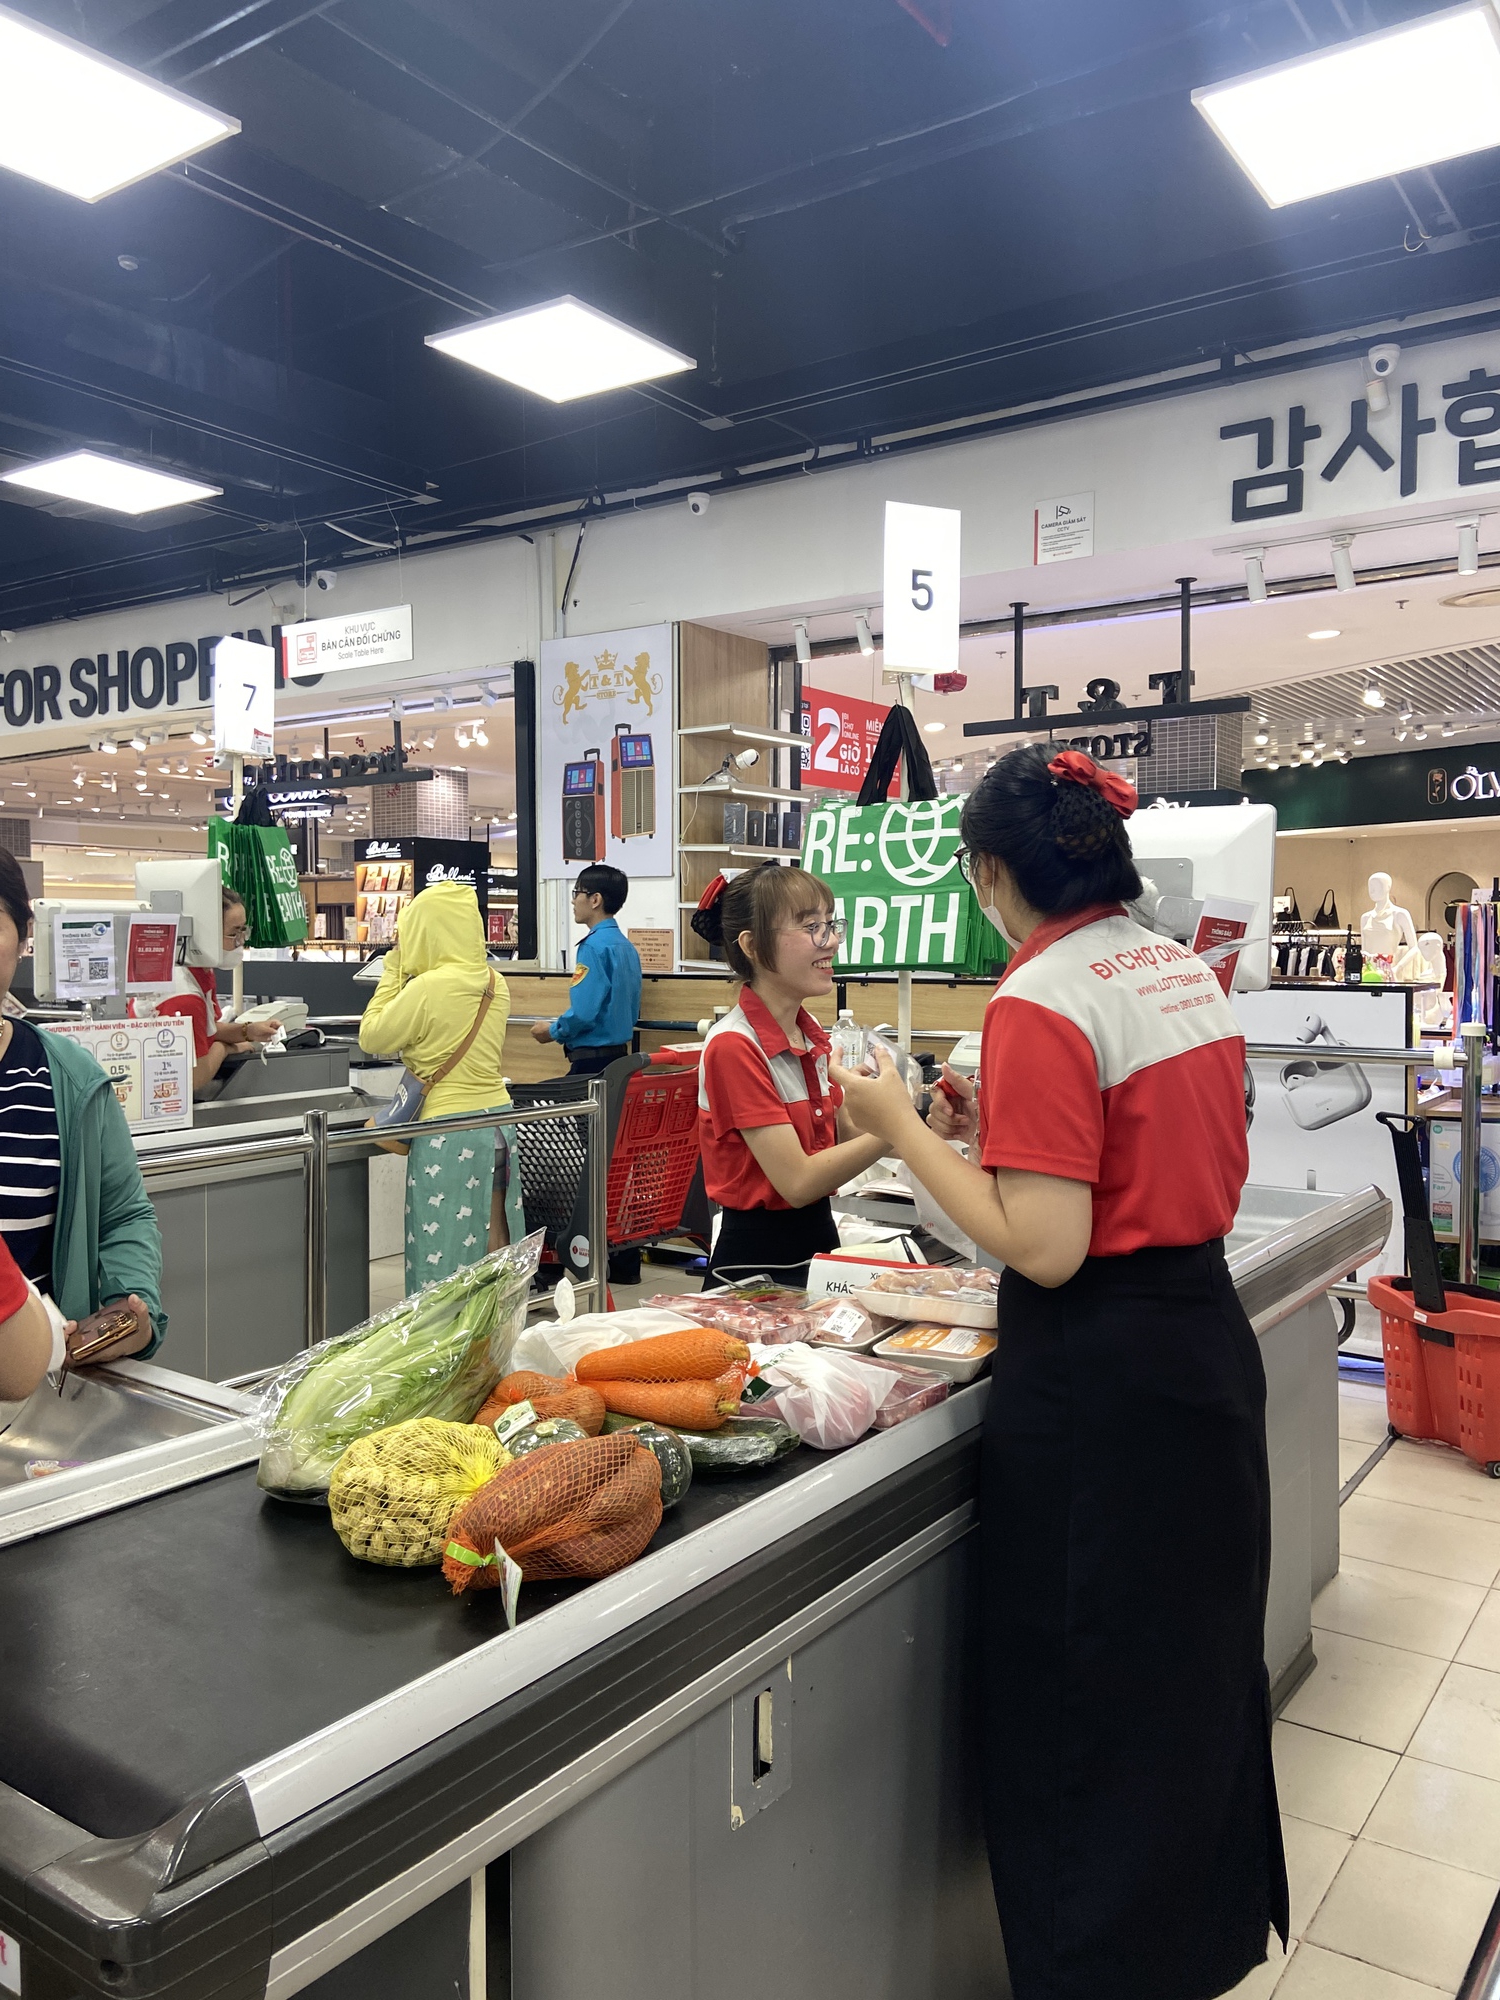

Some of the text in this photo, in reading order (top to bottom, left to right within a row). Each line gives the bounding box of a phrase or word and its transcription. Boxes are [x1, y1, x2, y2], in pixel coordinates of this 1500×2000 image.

[911, 569, 934, 611] 5
[345, 621, 376, 634] KHU VỰC
[321, 630, 401, 651] BÀN CÂN ĐỐI CHỨNG
[338, 646, 384, 660] Scale Table Here
[601, 674, 612, 686] &
[0, 665, 62, 727] OR
[243, 683, 257, 711] 7
[596, 690, 617, 699] STORE
[814, 707, 841, 773] 2
[1089, 958, 1121, 980] ĐI
[1115, 945, 1160, 971] CHỢ
[1433, 1183, 1446, 1191] Fan
